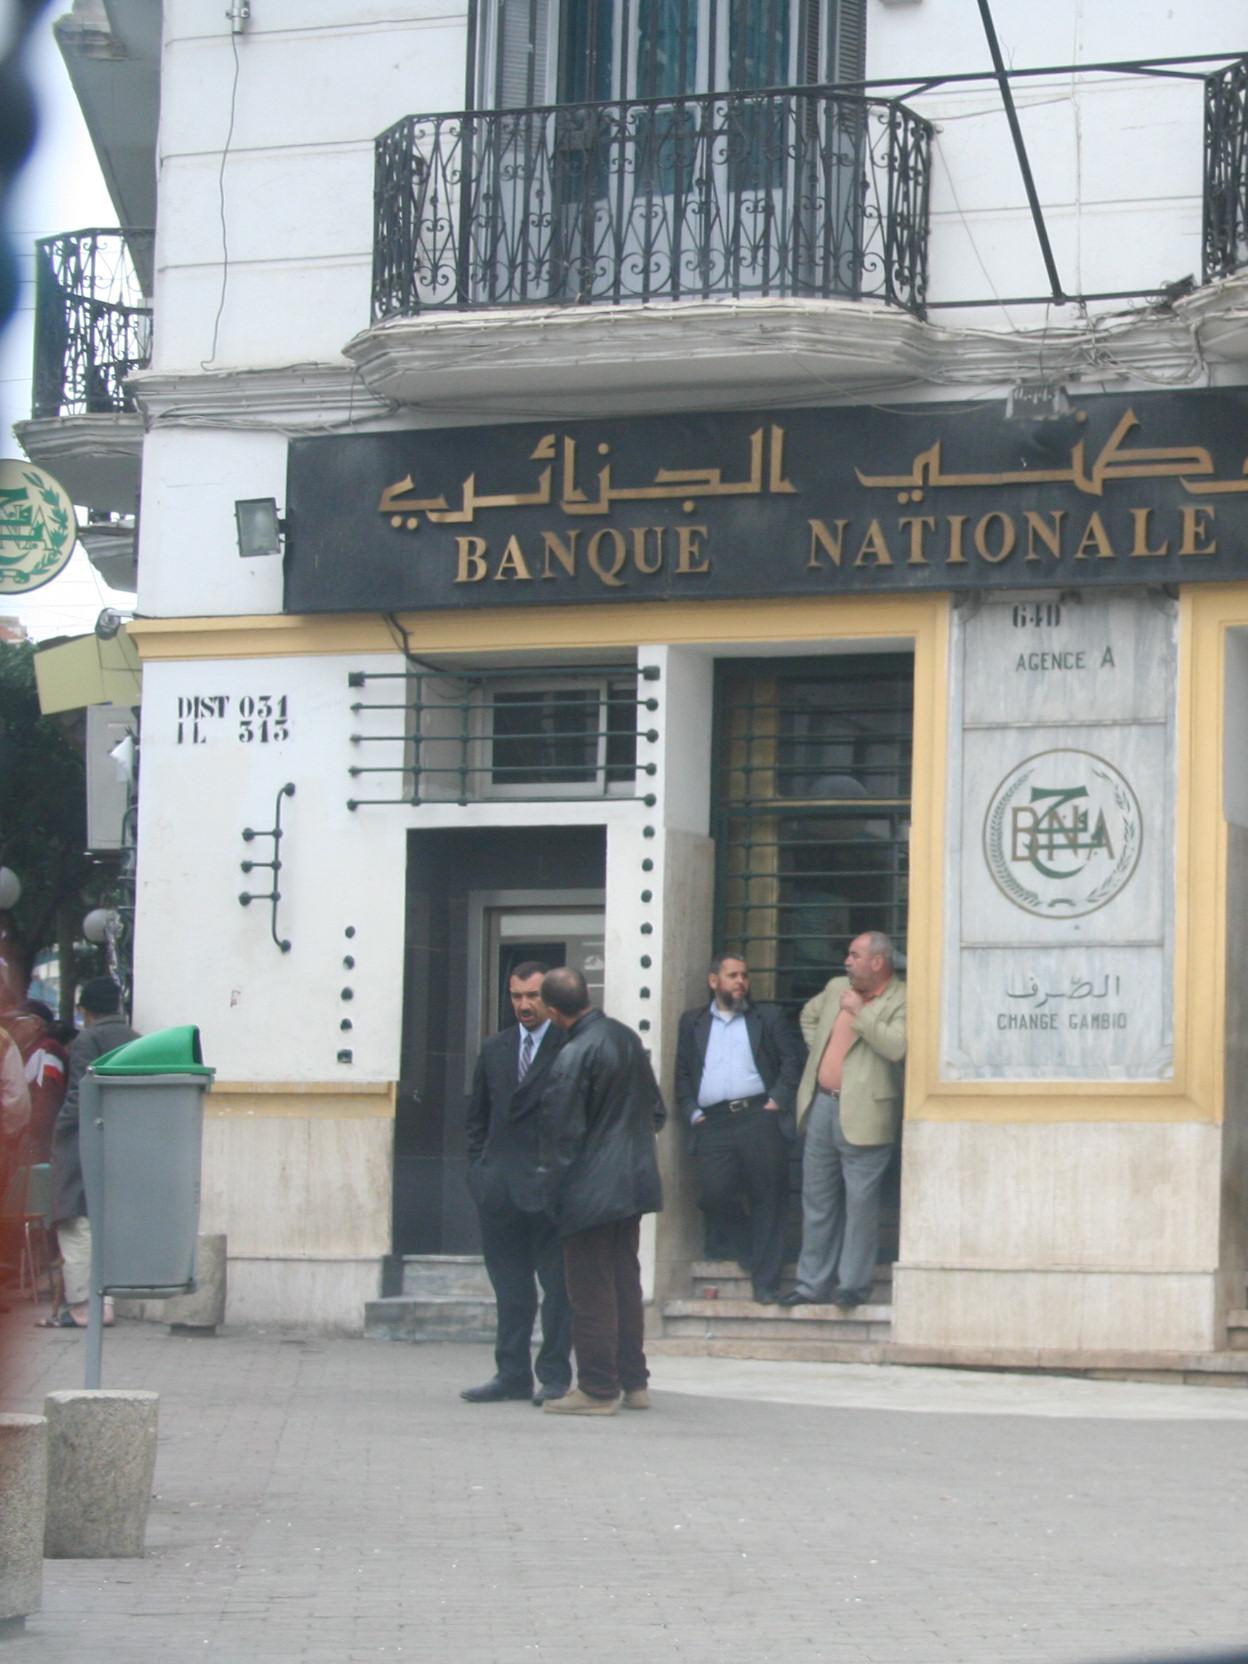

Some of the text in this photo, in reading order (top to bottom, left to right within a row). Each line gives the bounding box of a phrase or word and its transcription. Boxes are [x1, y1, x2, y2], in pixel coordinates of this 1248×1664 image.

[378, 423, 798, 530] الجزائري
[453, 524, 711, 588] BANQUE
[807, 504, 1218, 568] NATIONALE
[1016, 645, 1116, 672] AGENCE A
[178, 695, 231, 719] DIST
[996, 1012, 1059, 1031] CHANGE
